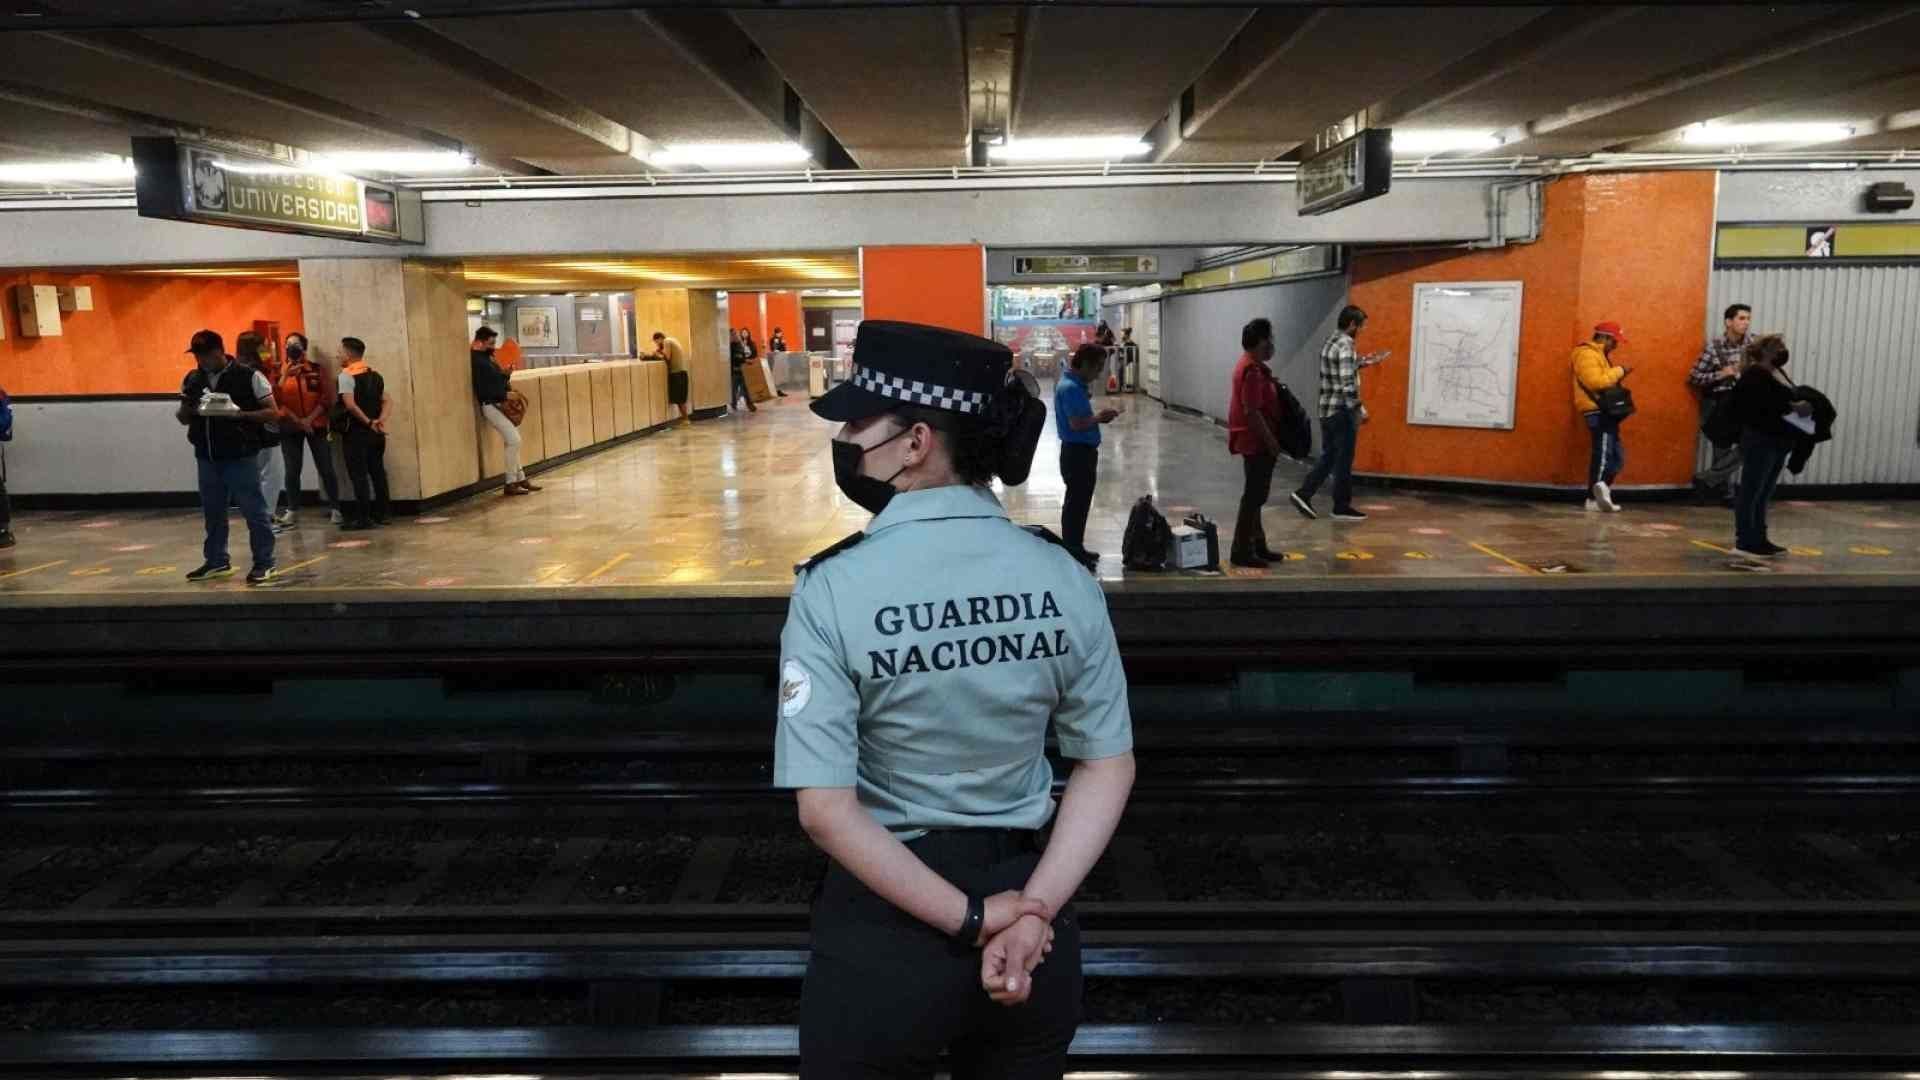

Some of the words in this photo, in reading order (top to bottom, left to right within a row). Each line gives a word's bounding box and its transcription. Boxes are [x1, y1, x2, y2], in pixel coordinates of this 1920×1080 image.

[230, 185, 359, 225] UNIVERSIDAD
[874, 591, 1063, 636] GUARDIA
[868, 629, 1070, 680] NACIONAL
